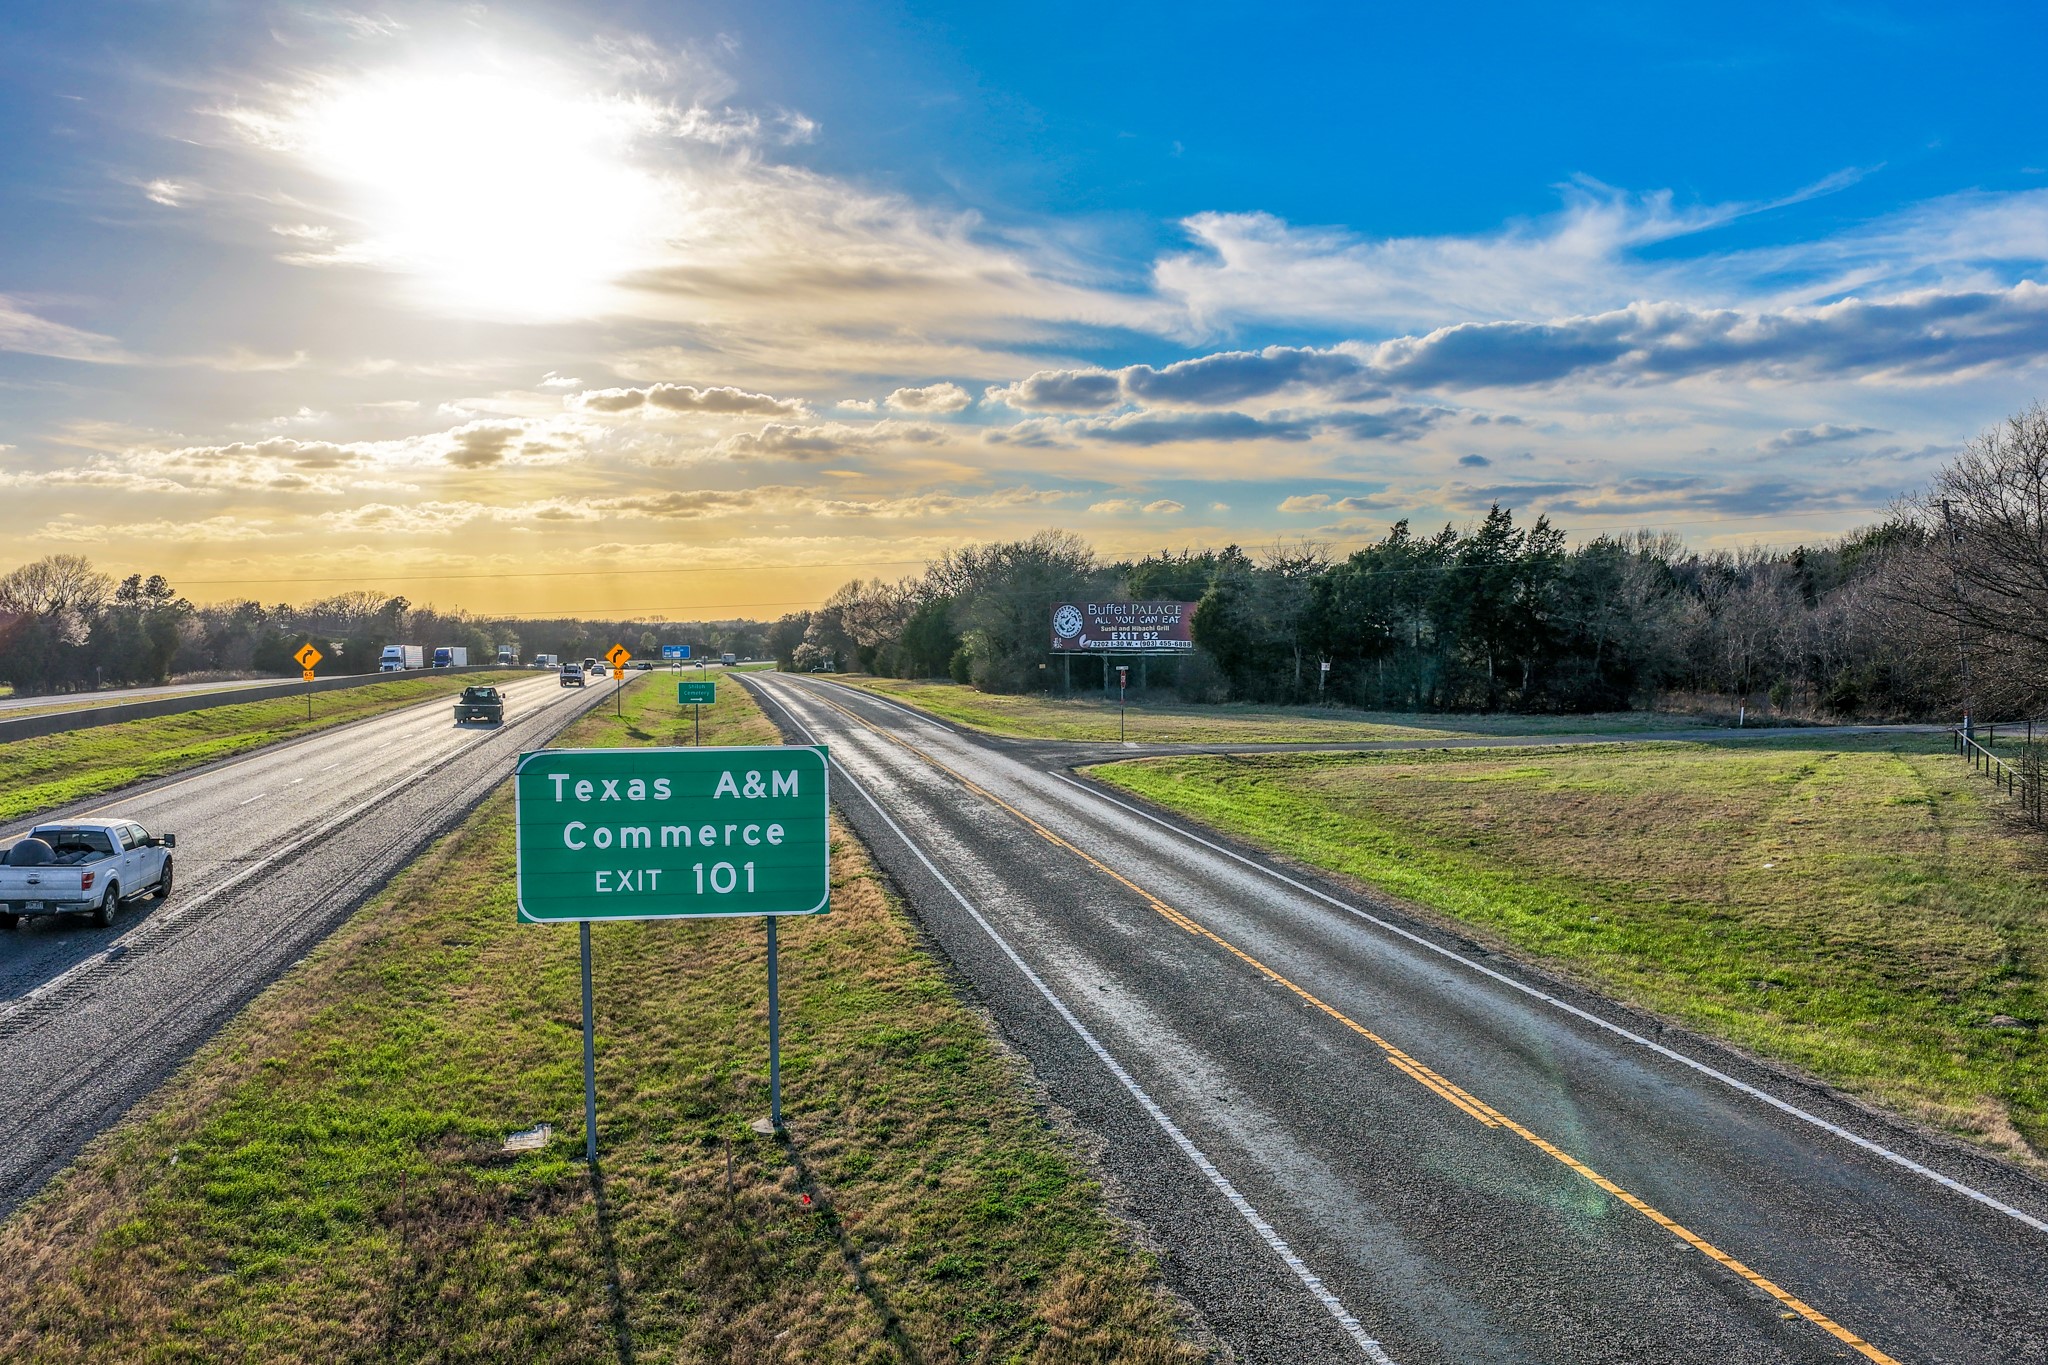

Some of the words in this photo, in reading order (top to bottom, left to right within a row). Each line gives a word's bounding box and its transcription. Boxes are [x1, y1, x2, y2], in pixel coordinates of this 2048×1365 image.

[1088, 604, 1127, 615] Buffet
[1131, 604, 1182, 615] PALACE
[1095, 616, 1111, 624] ALL
[1115, 616, 1135, 624] YOU
[1139, 616, 1158, 624] CAN
[1162, 616, 1181, 624] EAT
[1111, 632, 1139, 640] EXIT
[1142, 632, 1159, 640] 92
[548, 773, 672, 802] Texas
[713, 770, 799, 799] A&M
[563, 821, 785, 850] Commerce
[595, 869, 662, 892] EXIT
[692, 861, 755, 895] 101
